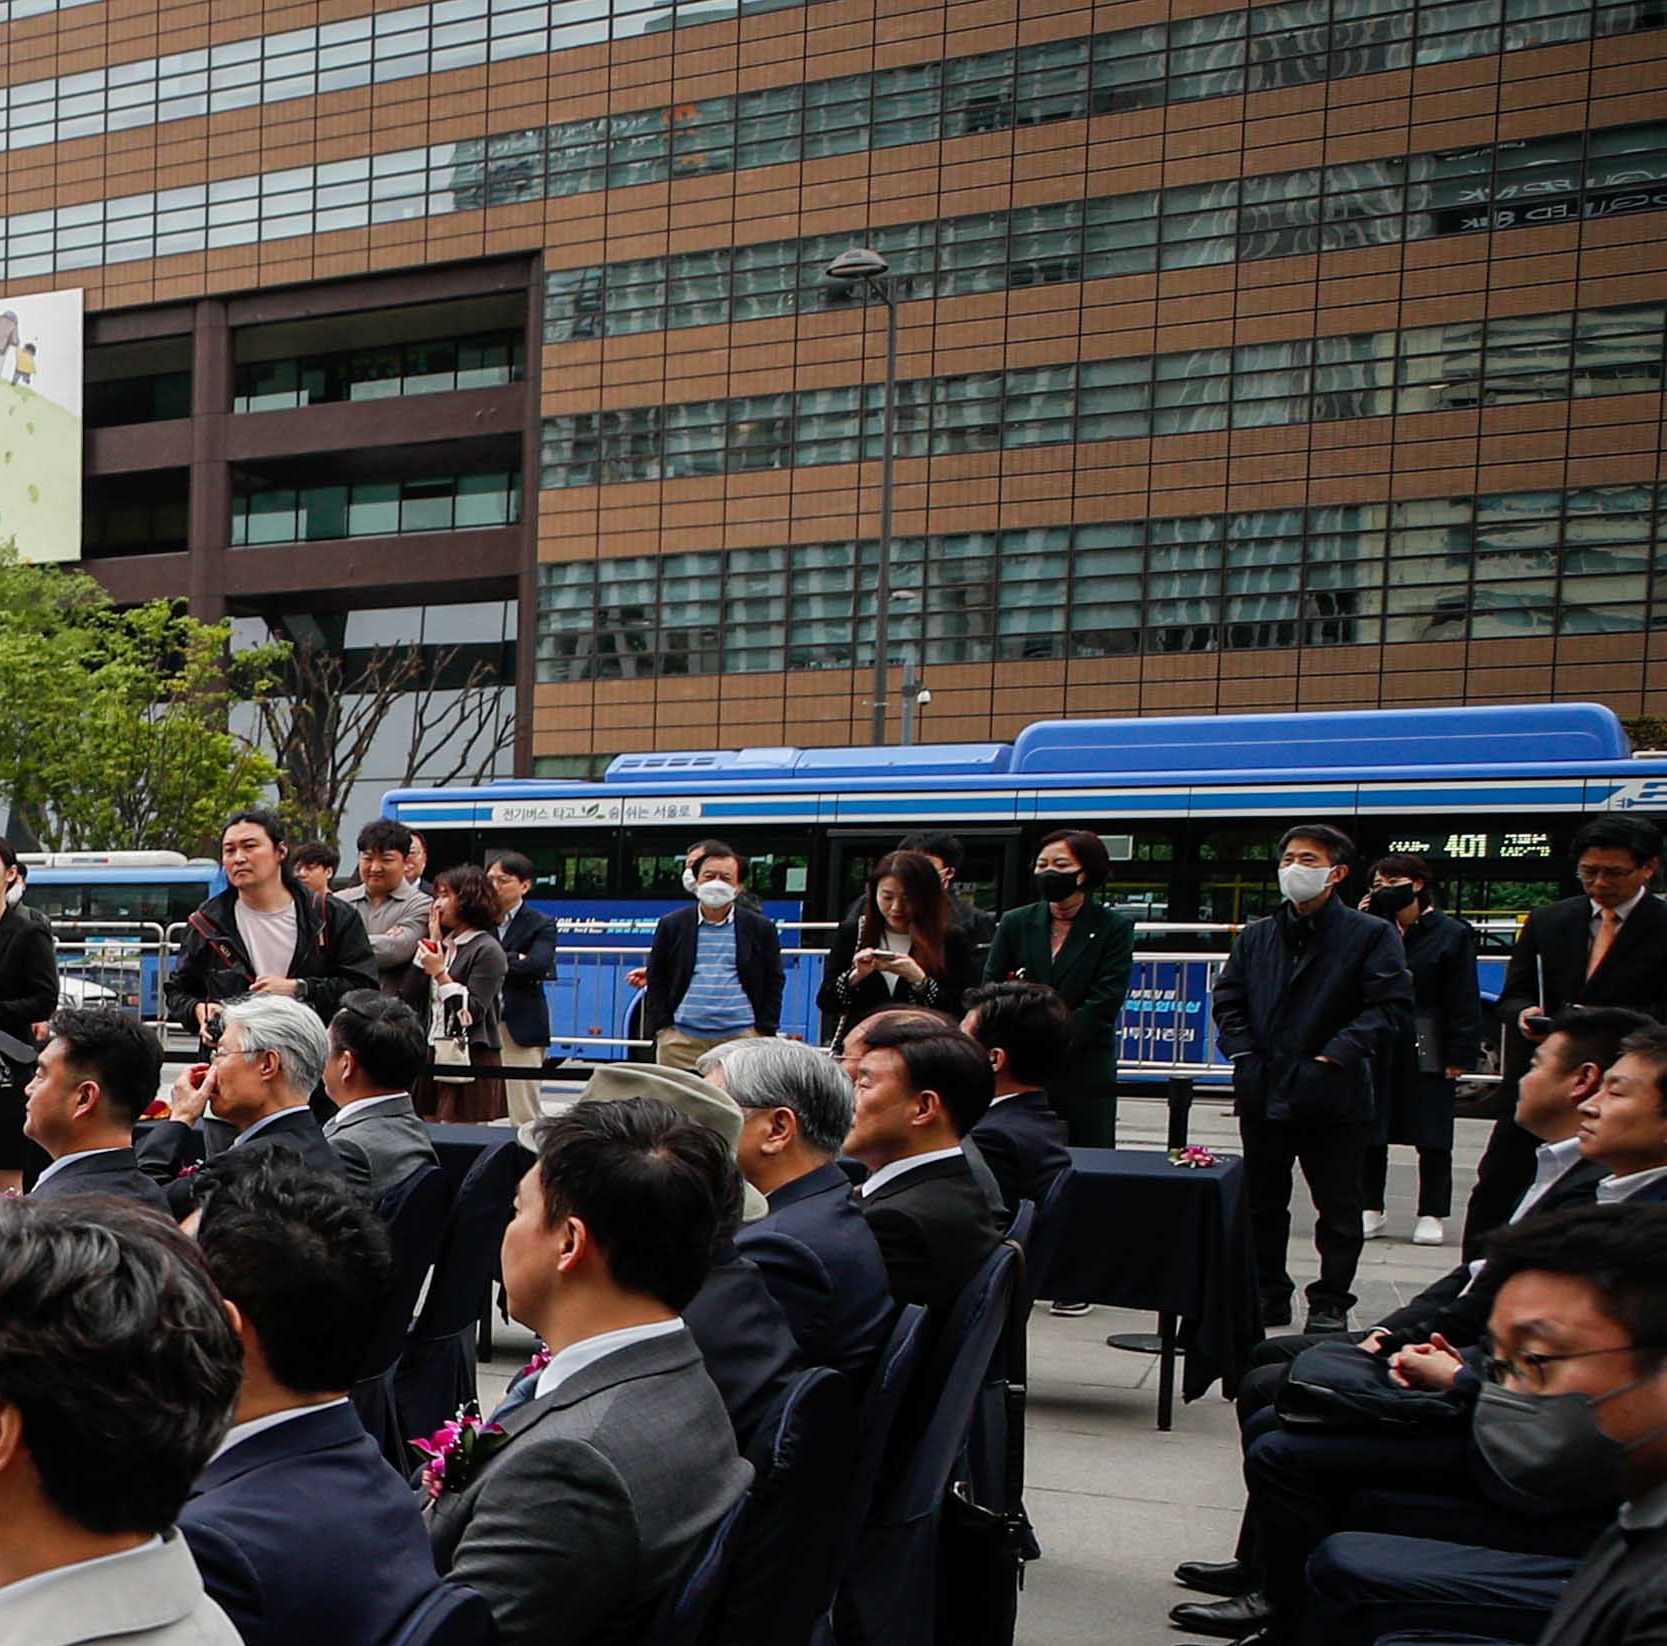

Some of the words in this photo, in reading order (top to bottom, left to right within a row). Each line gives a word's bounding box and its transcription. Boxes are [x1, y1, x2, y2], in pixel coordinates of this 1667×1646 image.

[502, 807, 549, 822] 전기버스
[553, 806, 576, 820] 타고
[608, 806, 620, 820] 숨
[625, 805, 649, 820] 쉬는
[654, 804, 692, 819] 서울로
[1443, 833, 1488, 858] 401
